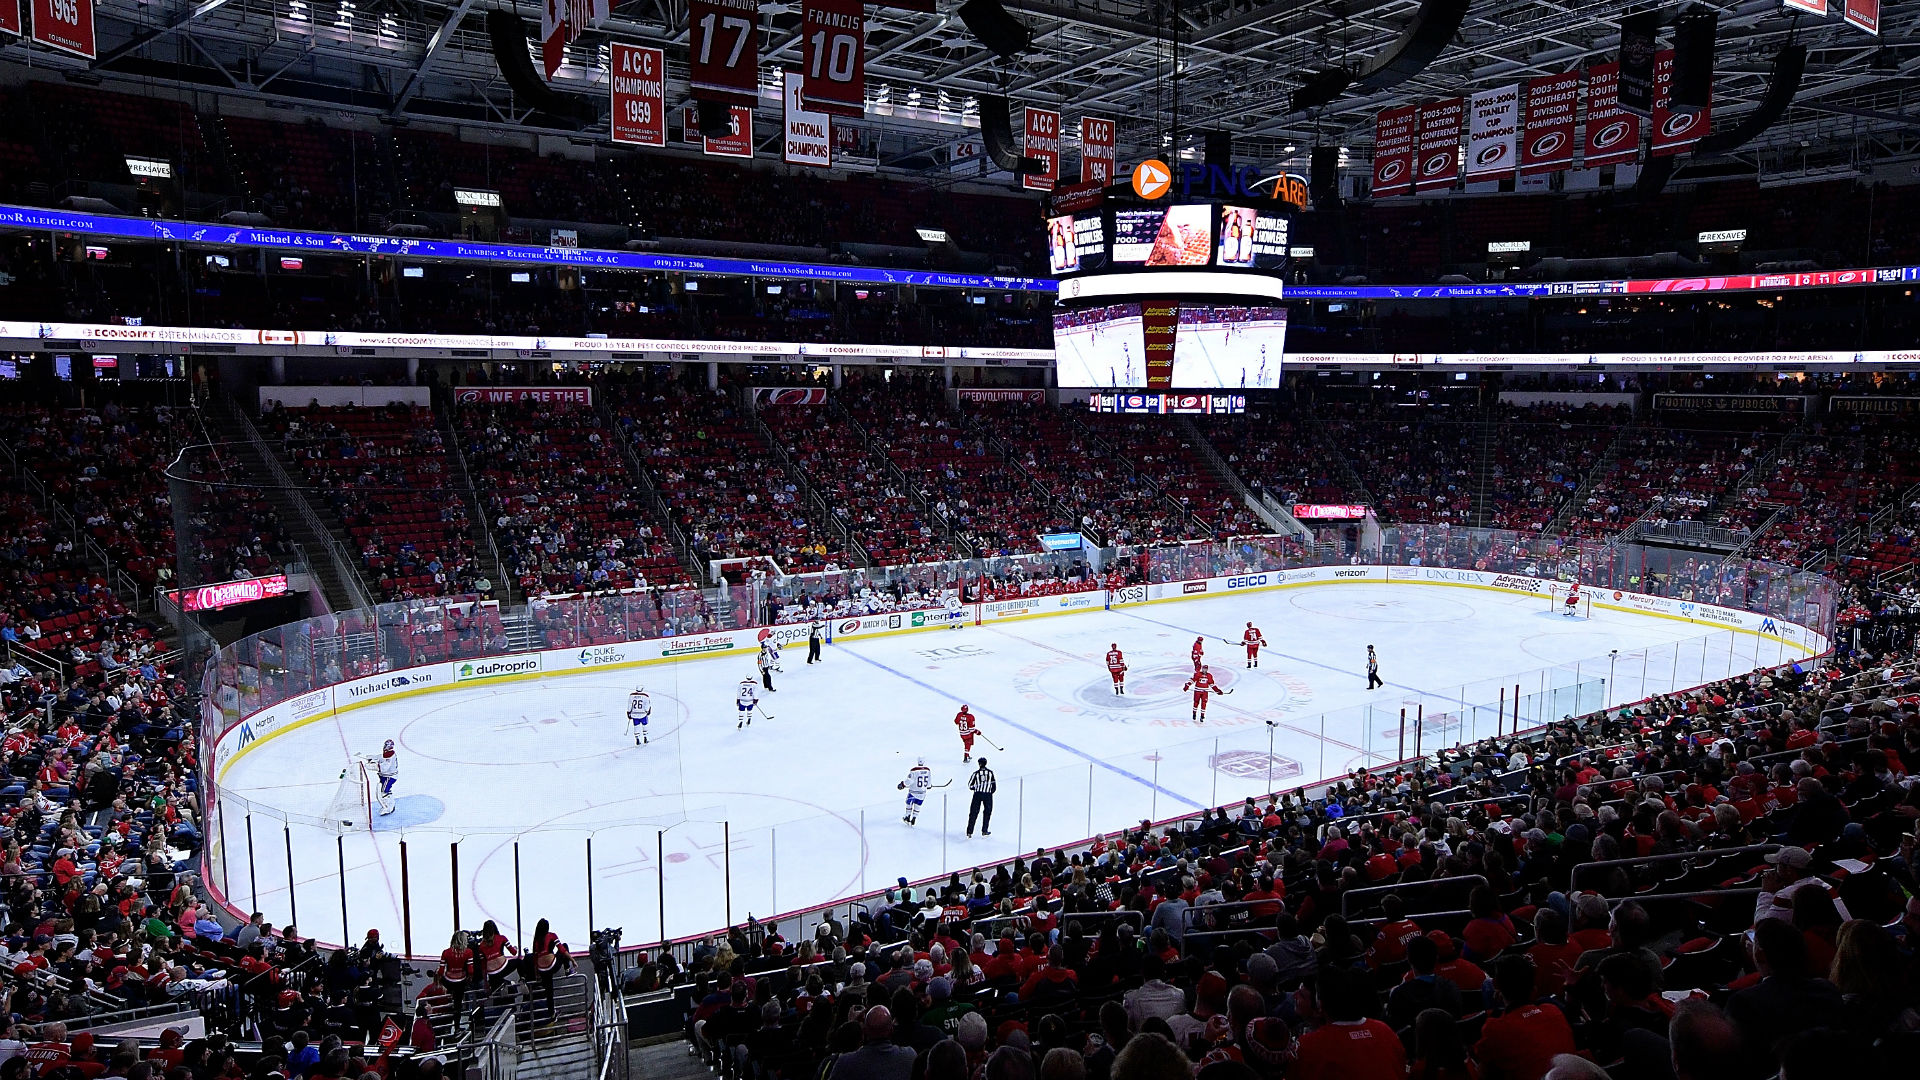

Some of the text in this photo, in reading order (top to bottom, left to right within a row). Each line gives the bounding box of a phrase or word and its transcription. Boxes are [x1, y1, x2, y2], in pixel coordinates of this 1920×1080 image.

[808, 9, 860, 30] FRANCIS
[48, 34, 82, 49] TOURNAMENT
[700, 13, 751, 67] 17
[622, 50, 652, 75] ACC
[811, 31, 858, 83] 10
[614, 76, 660, 98] CHAMPIONS
[1531, 79, 1578, 96] 2005-2006
[1589, 84, 1618, 97] SOUTH
[1474, 93, 1517, 109] 2005-2006
[1529, 91, 1576, 107] SOUTHEAST
[1593, 96, 1619, 108] DIVISI
[625, 99, 651, 124] 1959
[1422, 105, 1461, 119] 2005-2006
[1478, 105, 1511, 118] STANLEY
[1533, 104, 1569, 118] DIVISION
[1033, 113, 1053, 134] ACC
[1378, 115, 1413, 128] 2001-2002
[1426, 117, 1456, 129] EASTERN
[1486, 118, 1502, 128] CUP
[1527, 115, 1573, 130] CHAMPIONS
[790, 121, 825, 139] NATIONAL
[1090, 122, 1108, 142] ACC
[1381, 126, 1408, 137] EASTERN
[1421, 127, 1460, 140] CONFERENCE
[1471, 127, 1515, 141] CHAMPIONS
[1027, 134, 1058, 152] CHAMPIONS
[1376, 134, 1411, 148] CONFERENCE
[1420, 137, 1459, 151] CHAMPIONS
[788, 141, 828, 158] CHAMPIONS
[956, 143, 974, 157] 24
[1083, 143, 1113, 160] CHAMPIONS
[1375, 145, 1411, 158] CHAMPIONS
[128, 163, 171, 175] #REXSAVES
[1090, 161, 1107, 181] 1954
[1182, 162, 1260, 198] PNC
[456, 191, 500, 202] UNC REX
[1074, 217, 1102, 233] GROWLERS
[1116, 224, 1133, 232] 109
[1255, 217, 1289, 232] GROWLERS
[250, 233, 325, 247] Michael & Son
[1079, 230, 1104, 245] HOWLERS
[1259, 231, 1288, 245] HOWLERS
[1699, 230, 1747, 242] #REXSAVES
[457, 246, 499, 258] PLUMBING
[507, 249, 553, 261] ELECTRICAL
[596, 255, 604, 263] &
[606, 255, 620, 264] AC
[653, 259, 672, 268] (919)
[937, 275, 980, 286] Michael & Son
[1861, 272, 1868, 283] 1
[1877, 269, 1902, 279] 15:01
[1911, 268, 1918, 280] 1
[1448, 287, 1475, 296] Michael
[1483, 287, 1497, 295] Son
[94, 328, 243, 341] ECONOMY EXTERMINATORS
[691, 344, 726, 352] PROVIDER
[489, 391, 585, 402] WE ARE THE
[1120, 395, 1125, 408] 1
[1201, 395, 1206, 409] 1
[1660, 397, 1780, 410] FOOTHILLS PUBDECK
[1837, 400, 1899, 412] FOOTHILLS
[1334, 568, 1367, 577] verizon
[1426, 570, 1484, 583] UNC REX
[1227, 575, 1267, 589] GEICO
[1495, 575, 1530, 586] Advance
[1509, 582, 1529, 590] Parts
[1184, 583, 1206, 592] Lenovo
[201, 582, 261, 610] Cheerwine
[985, 598, 1040, 612] RALEIGH ORTHOPAEDIC
[1069, 599, 1091, 608] Lottery
[1681, 610, 1691, 618] NC
[862, 618, 888, 629] WATCH ON
[776, 626, 811, 641] pepsi
[670, 637, 733, 650] Harris Teeter
[594, 647, 615, 656] DUKE
[594, 654, 626, 664] ENERGY
[476, 659, 537, 675] duProprio
[348, 673, 432, 698] Michael Son
[741, 686, 753, 697] 24
[632, 699, 643, 710] 26
[255, 715, 276, 730] Martin
[916, 775, 928, 788] 65
